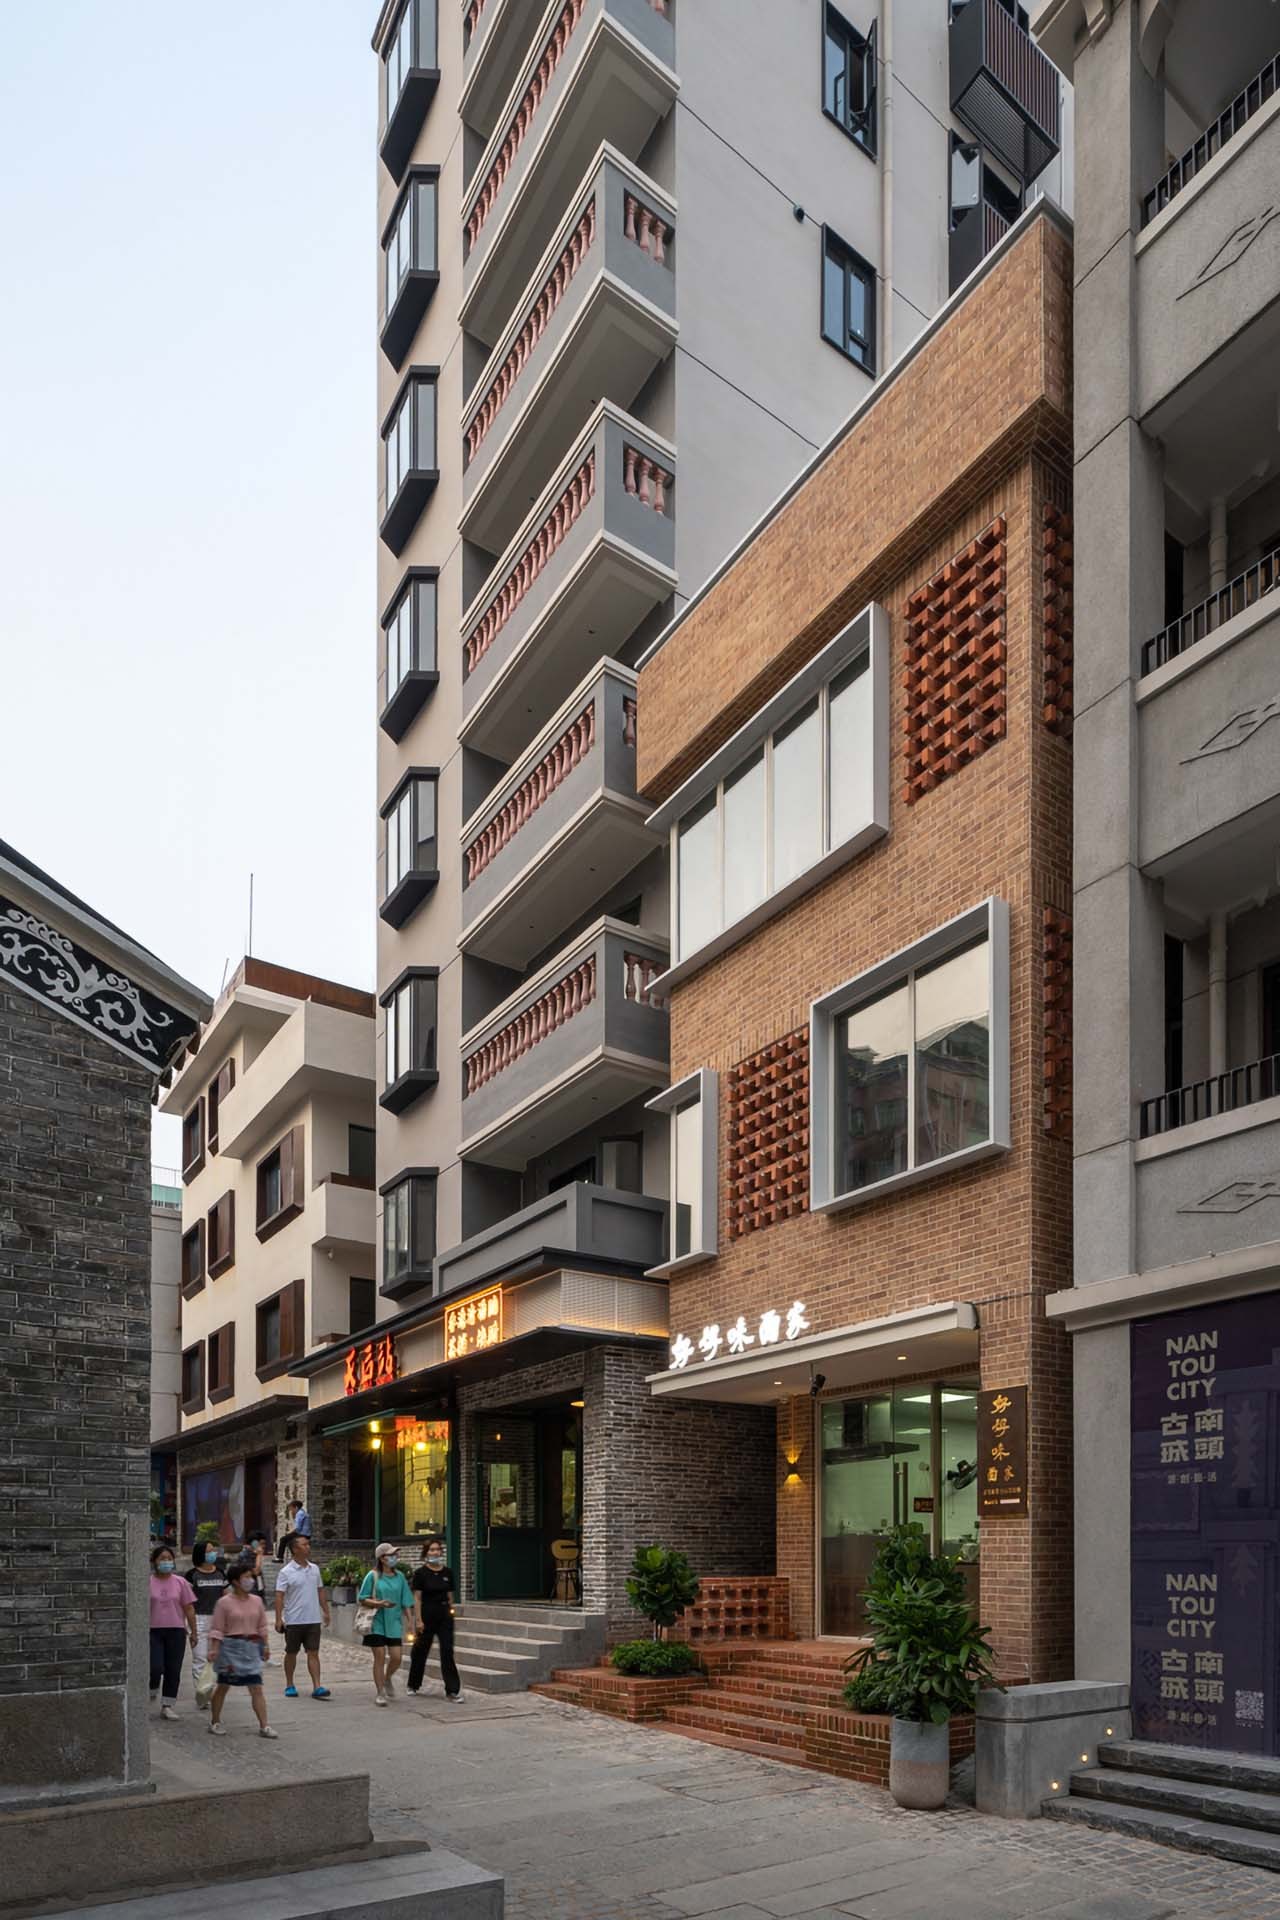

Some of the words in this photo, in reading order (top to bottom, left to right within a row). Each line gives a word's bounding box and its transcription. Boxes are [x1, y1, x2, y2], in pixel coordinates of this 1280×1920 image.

[1166, 1330, 1218, 1356] NAN
[1168, 1354, 1215, 1378] TOU
[1166, 1377, 1217, 1400] CITY
[1166, 1574, 1217, 1592] NAN
[1168, 1596, 1215, 1616] TOU
[1167, 1619, 1216, 1638] CITY
